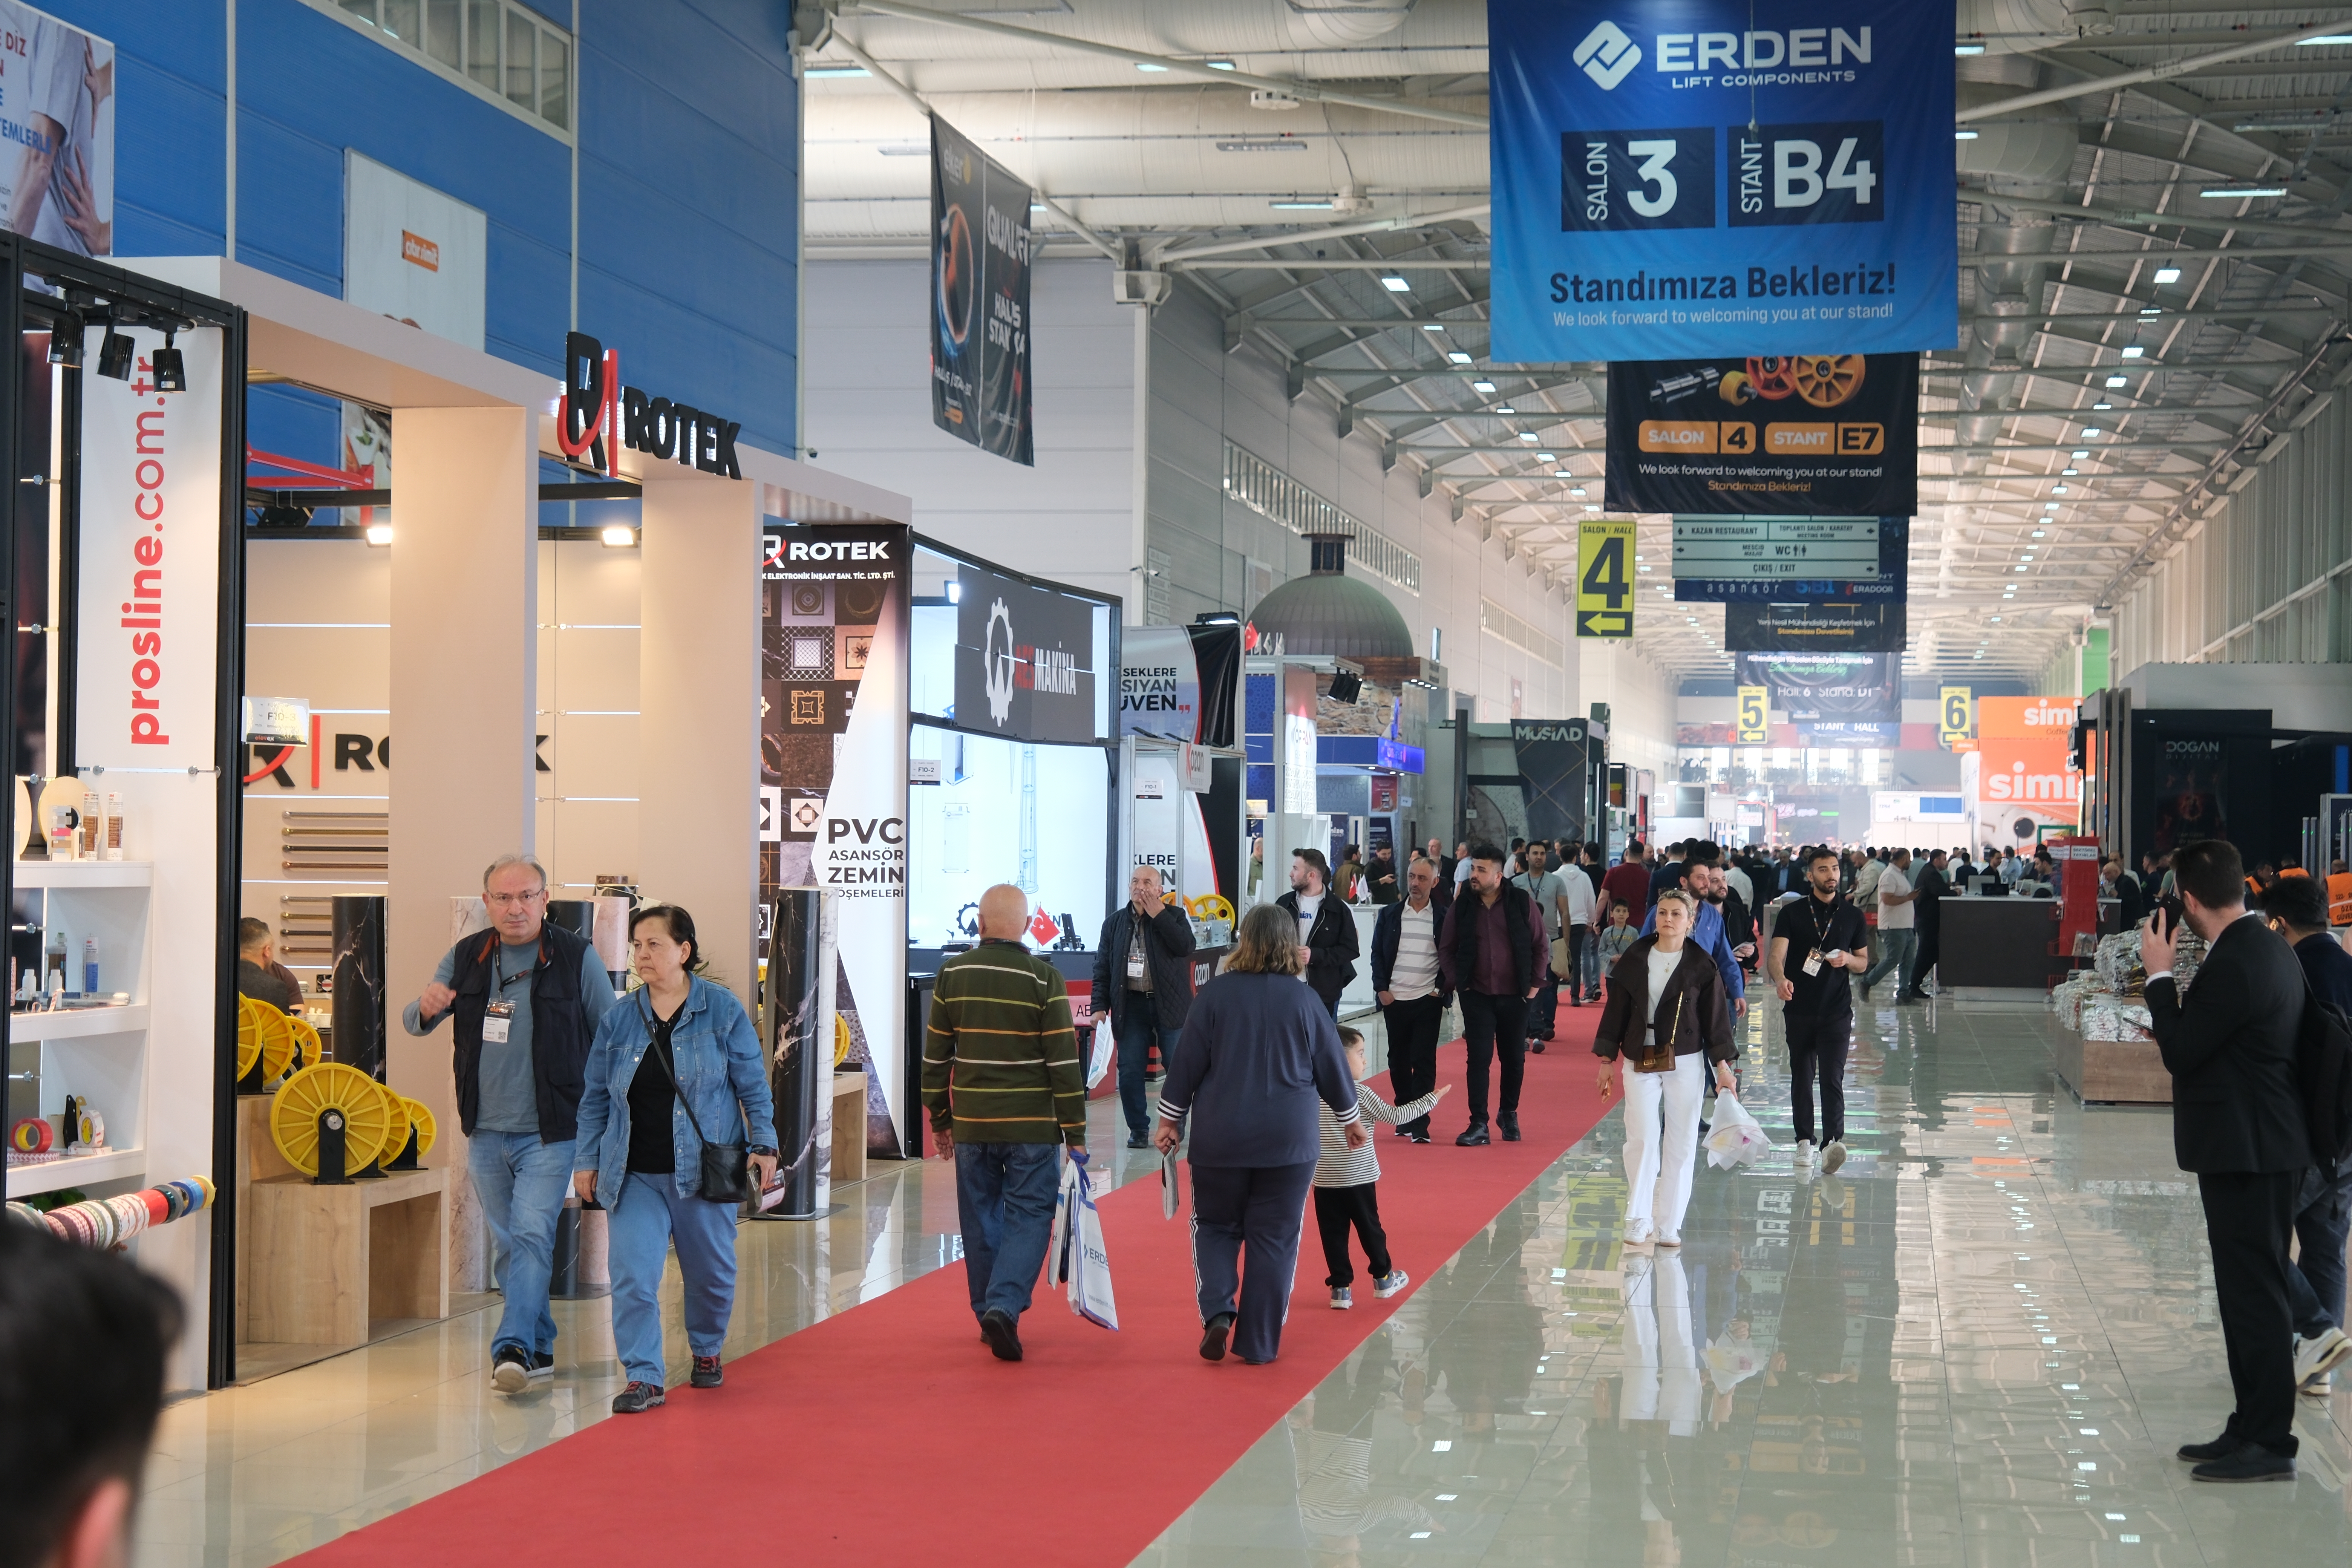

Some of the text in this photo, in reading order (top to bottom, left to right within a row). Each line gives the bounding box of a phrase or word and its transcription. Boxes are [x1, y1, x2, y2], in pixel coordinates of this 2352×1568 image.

[5, 29, 26, 57] DİZ
[1657, 26, 1872, 72] ERDEN
[1672, 70, 1856, 89] LIFT COMPONENTS
[1587, 141, 1608, 221] SALON
[1627, 139, 1678, 217] 3
[1741, 138, 1762, 214] STANT
[1773, 137, 1876, 208] B4
[1550, 263, 1896, 304] Standımıza Bekleriz!
[1553, 303, 1893, 326] We look forward to welcoming you at our stand!
[623, 386, 741, 480] ROTEK
[1649, 427, 1879, 450] SALON 4 STANT E7
[1639, 464, 1882, 479] We look forward to welcoming you at our stand!
[1708, 481, 1811, 492] Standımıza Bekleriz!
[121, 356, 169, 745] prosline.com.tr
[790, 541, 890, 560] ROTEK
[1775, 545, 1791, 555] WC
[1583, 537, 1629, 608] 4
[1853, 585, 1893, 593] ERADOOR
[1034, 641, 1076, 695] MAKİNA
[1123, 668, 1177, 677] SEKLERE
[1803, 687, 1811, 697] 6
[1743, 696, 1762, 728] 5
[1946, 696, 1966, 729] 6
[2024, 698, 2081, 726] simi
[1814, 723, 1880, 732] STANT HALL
[1989, 761, 2078, 799] simi
[828, 818, 903, 844] PVC
[828, 847, 904, 861] ASANSÖR
[828, 861, 904, 883] ZEMİN
[838, 886, 904, 900] ÖŞEMELERİ
